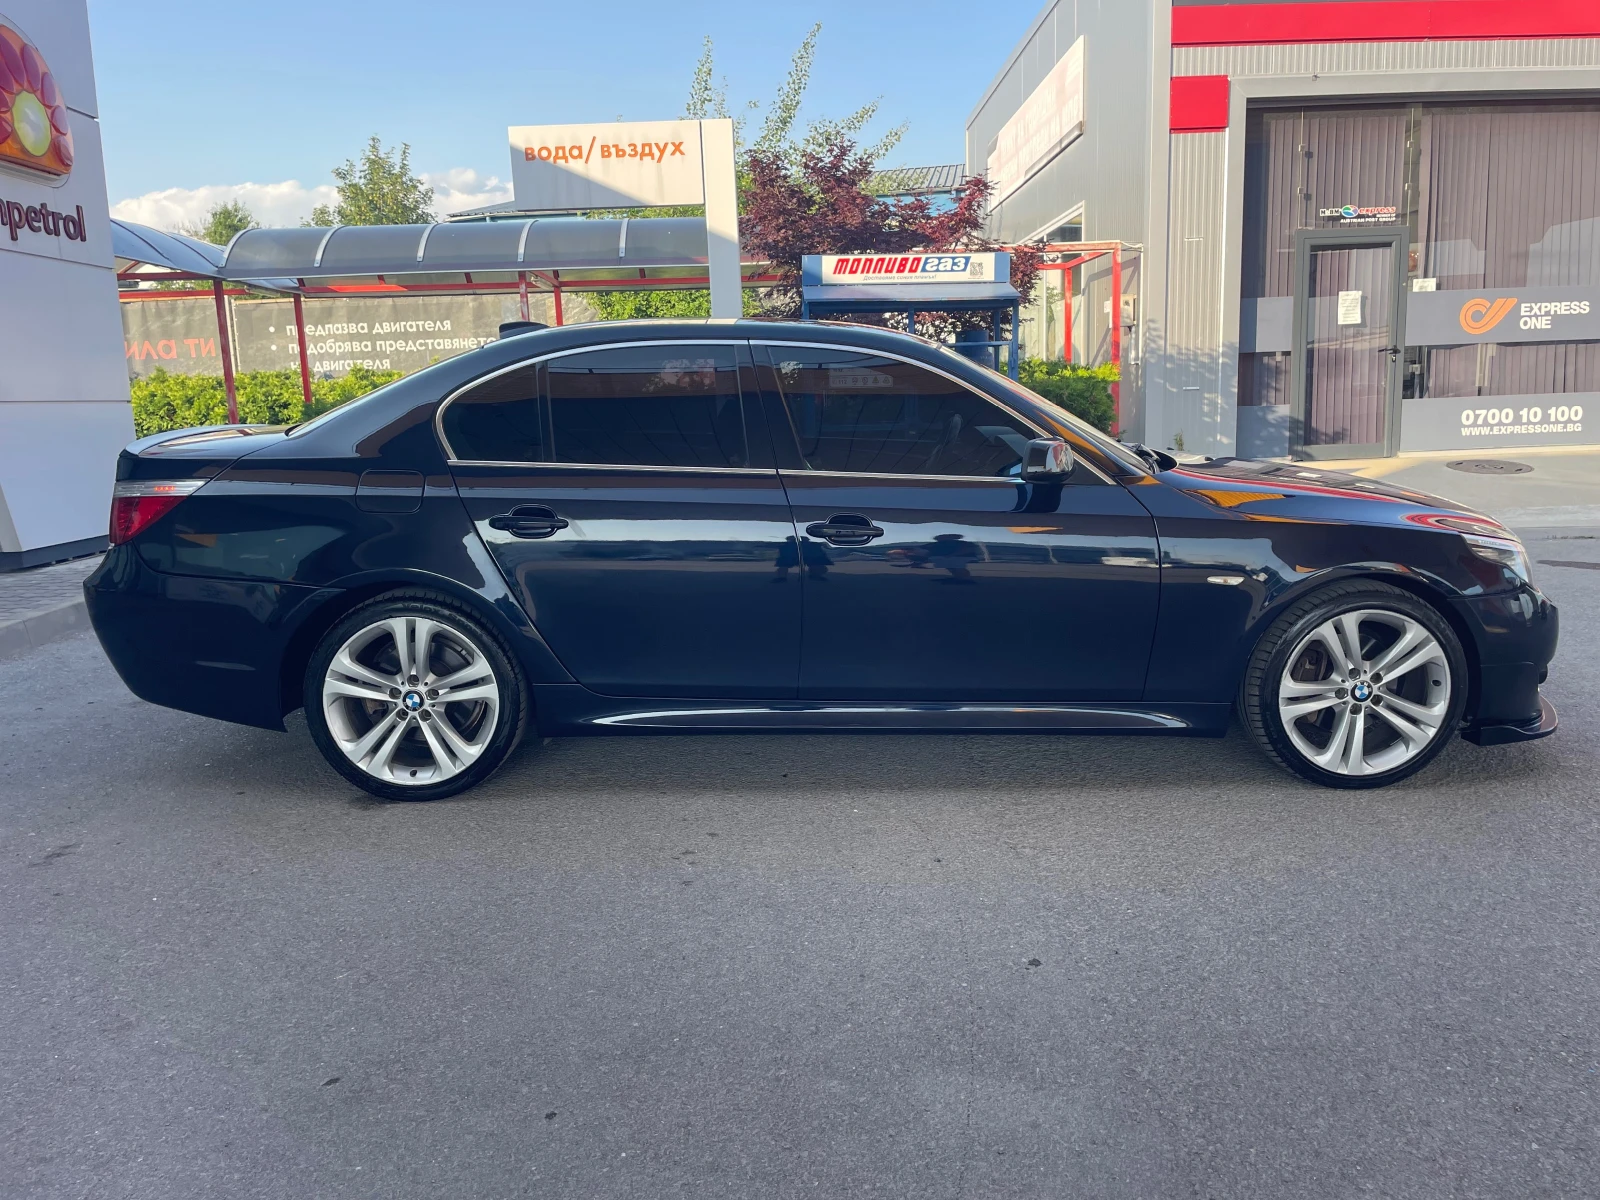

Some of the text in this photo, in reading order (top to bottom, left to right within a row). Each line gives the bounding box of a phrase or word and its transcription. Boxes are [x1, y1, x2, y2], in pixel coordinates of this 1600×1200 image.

[1520, 301, 1590, 316] EXPRESS
[286, 320, 452, 338] педпазва двигателя
[1519, 316, 1552, 329] ONE
[183, 337, 216, 358] ти
[288, 339, 372, 355] пдобрява
[1461, 405, 1583, 425] 0700 10 100
[1461, 423, 1582, 436] WWW.EXPRESSONE.BG
